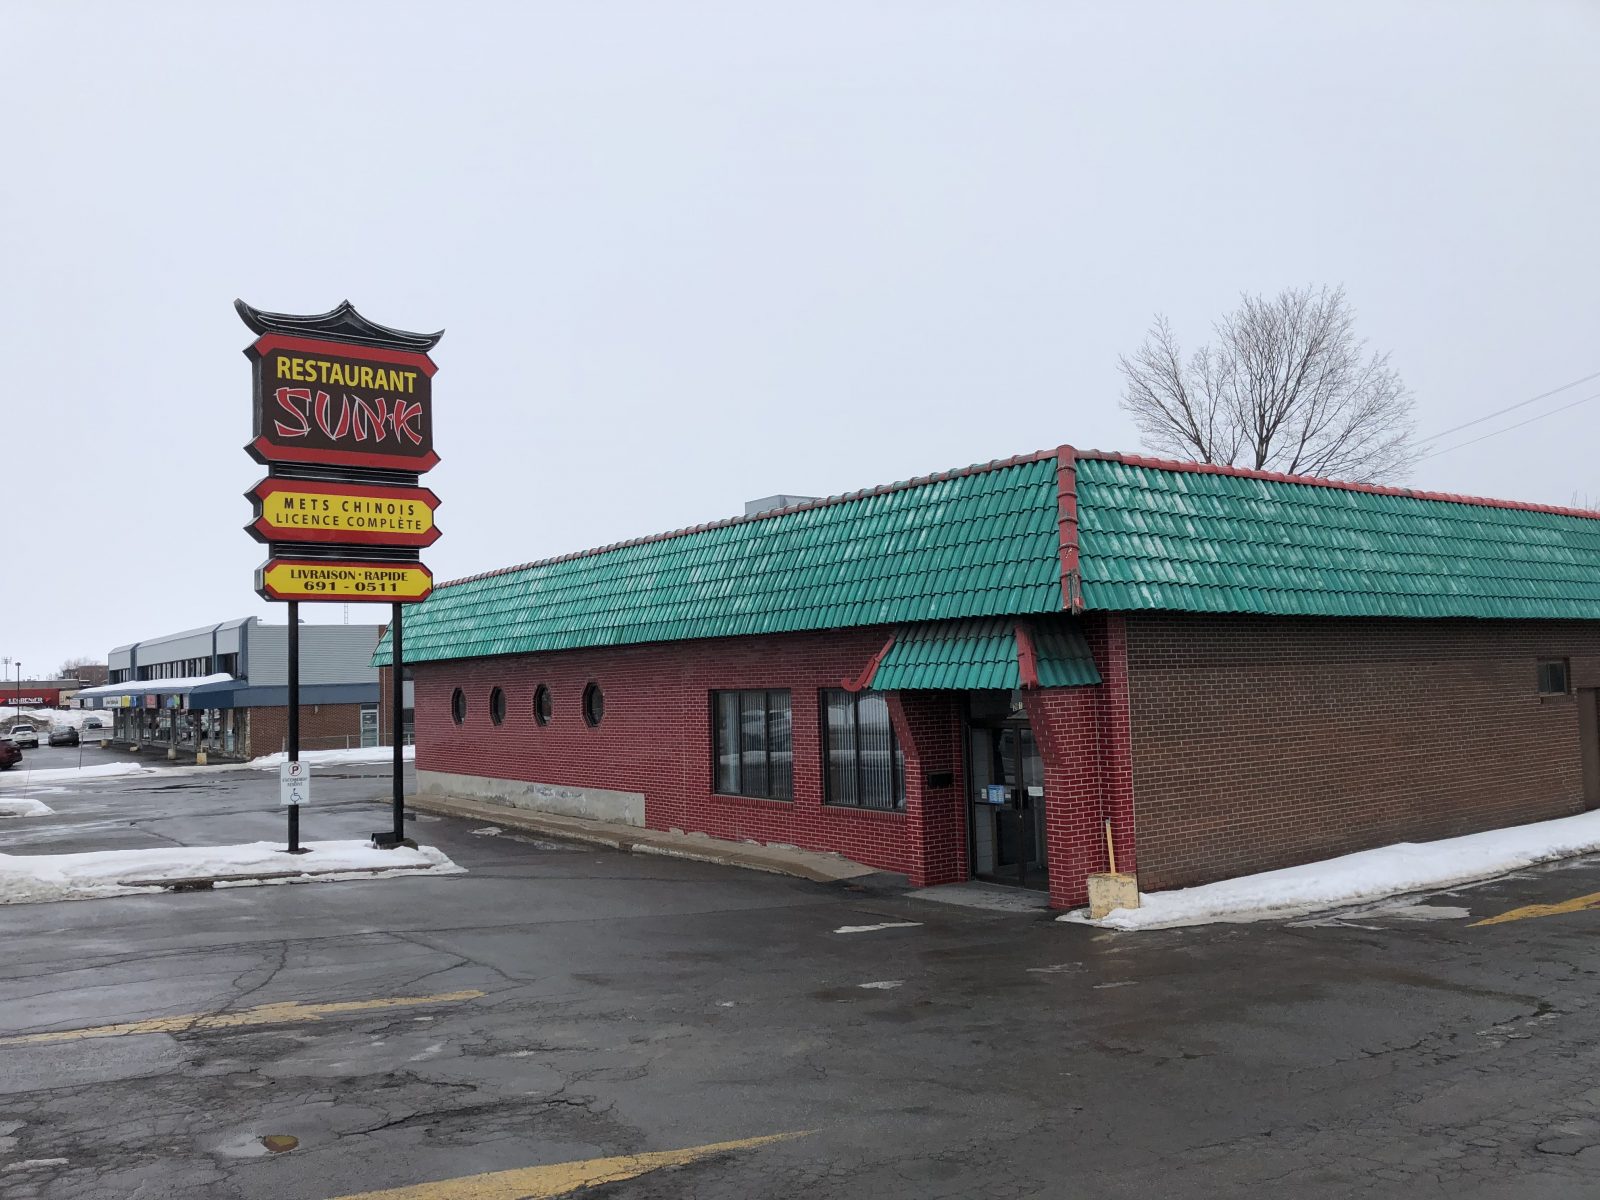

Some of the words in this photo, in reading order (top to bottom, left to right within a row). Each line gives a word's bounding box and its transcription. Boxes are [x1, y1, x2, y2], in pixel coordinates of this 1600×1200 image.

[277, 356, 417, 393] RESTAURANT
[284, 497, 329, 511] METS
[341, 500, 414, 516] CHINOIS
[276, 513, 340, 526] LICENCE
[347, 516, 422, 530] COMPLÈTE
